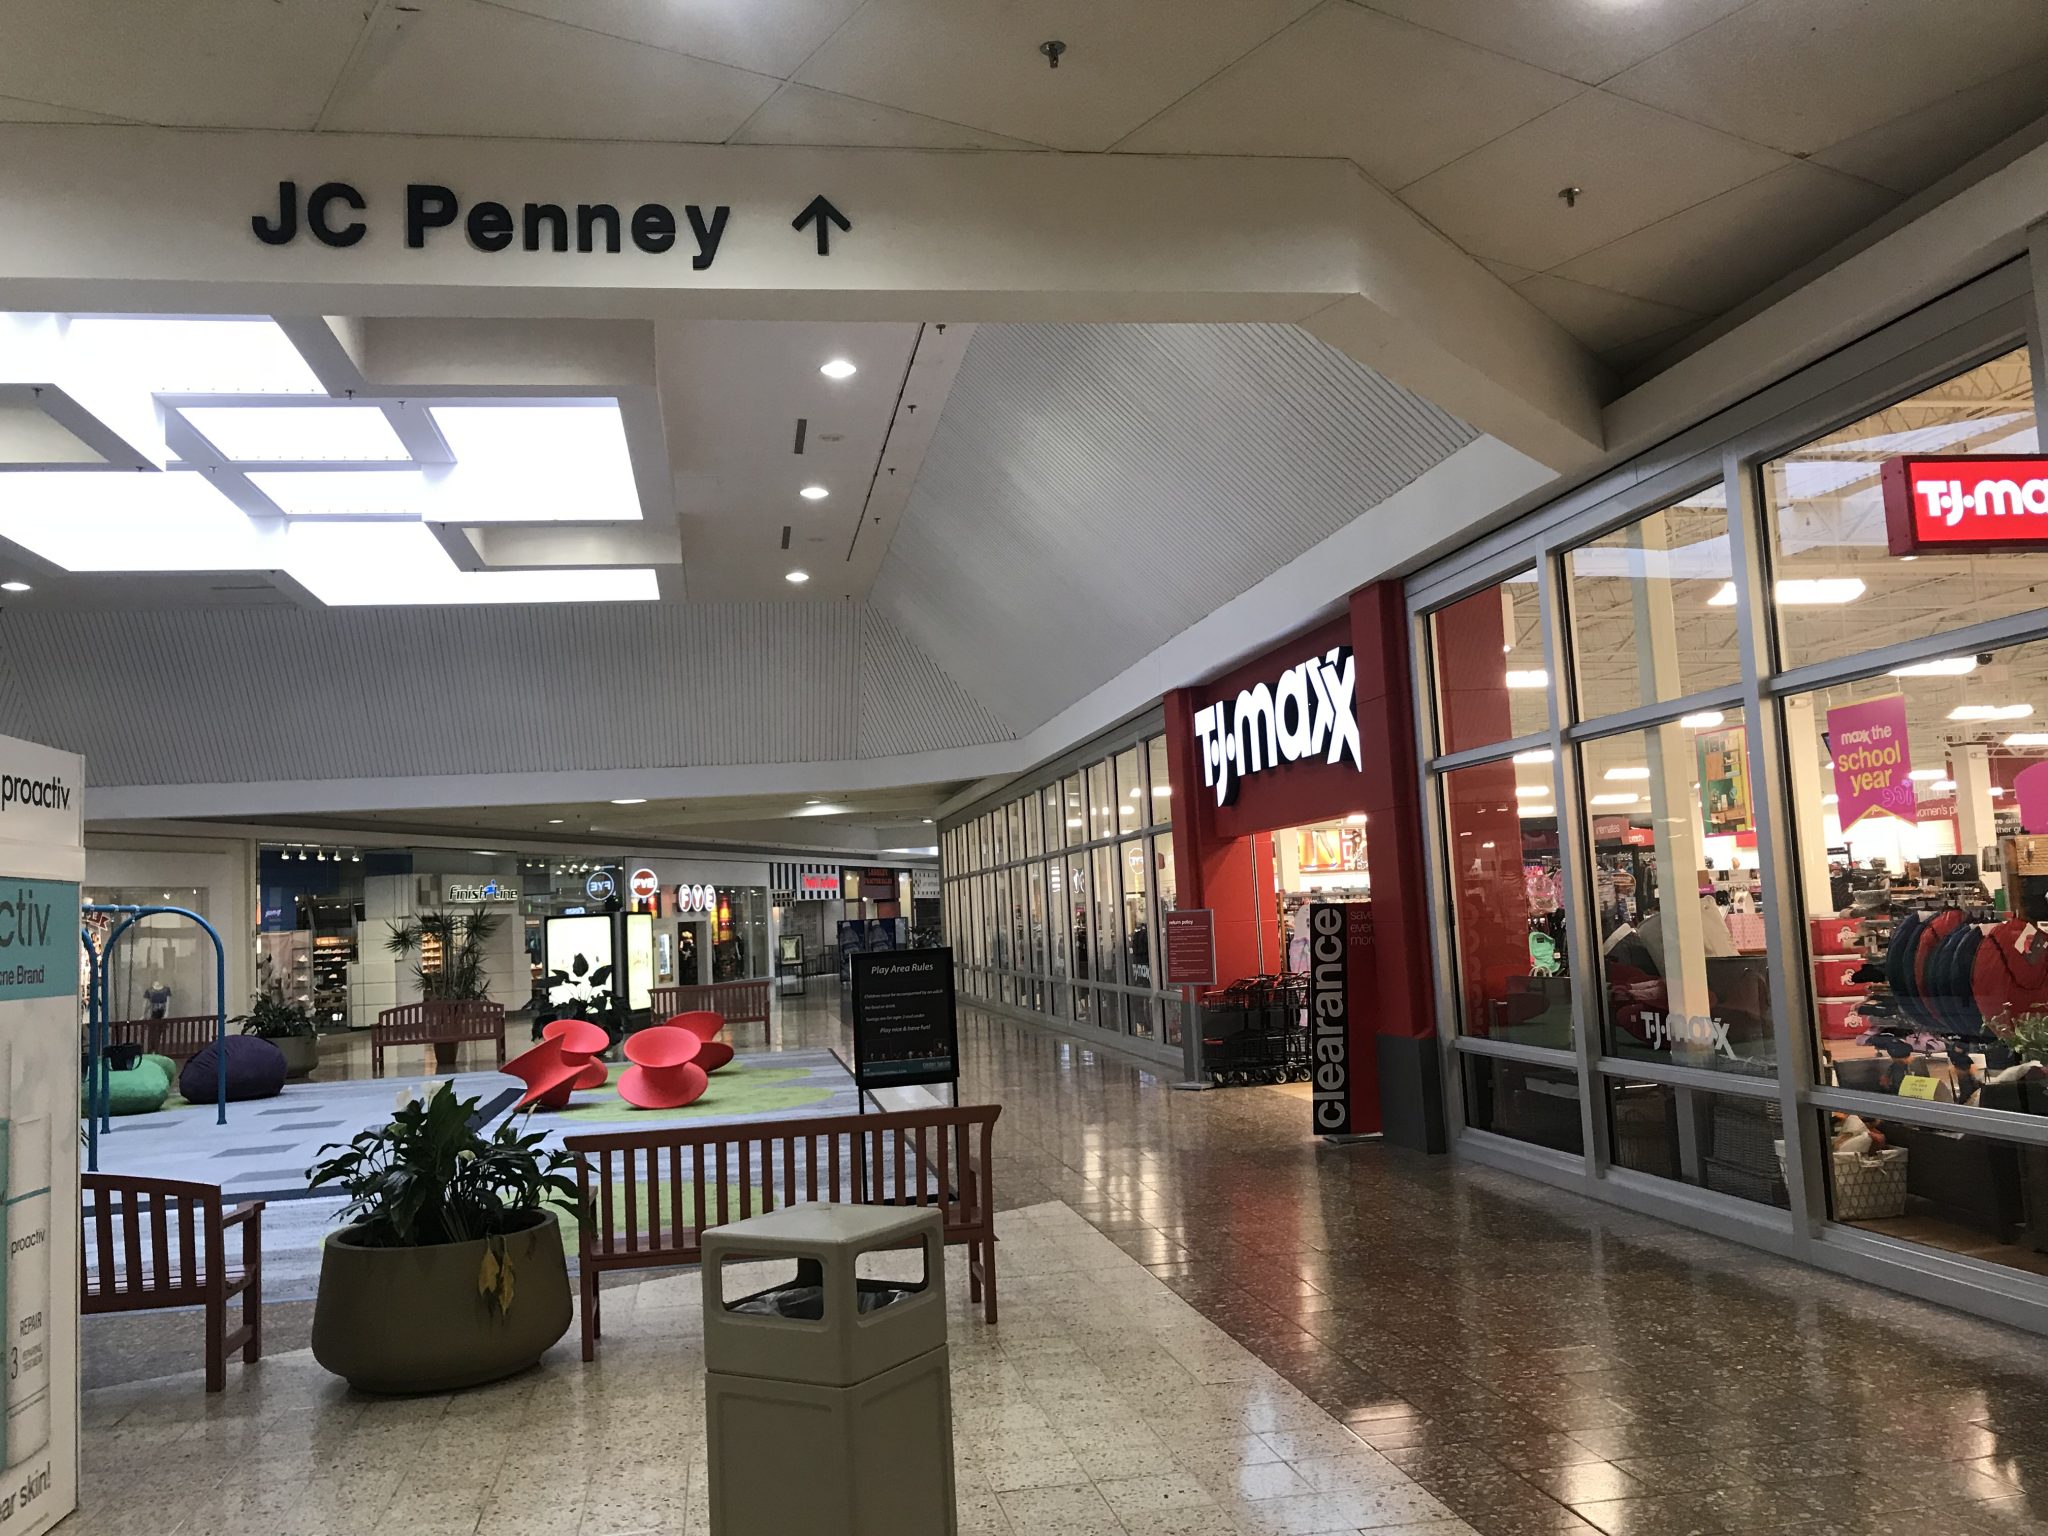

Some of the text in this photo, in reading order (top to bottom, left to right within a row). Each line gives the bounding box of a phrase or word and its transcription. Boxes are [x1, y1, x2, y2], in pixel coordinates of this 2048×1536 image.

[251, 181, 730, 271] JC Penney
[1871, 724, 1892, 740] the
[1838, 740, 1902, 772] school
[2, 774, 71, 811] proactiv
[1850, 768, 1893, 797] year
[449, 884, 518, 903] Finish Line
[633, 878, 656, 889] FYE
[680, 886, 715, 910] FYE
[0, 964, 45, 985] ne Brand
[871, 962, 934, 975] Play Area Rules
[1314, 908, 1346, 1129] clearance
[11, 1227, 46, 1260] proactiv
[11, 1346, 18, 1380] 3
[20, 1460, 51, 1508] skin!
